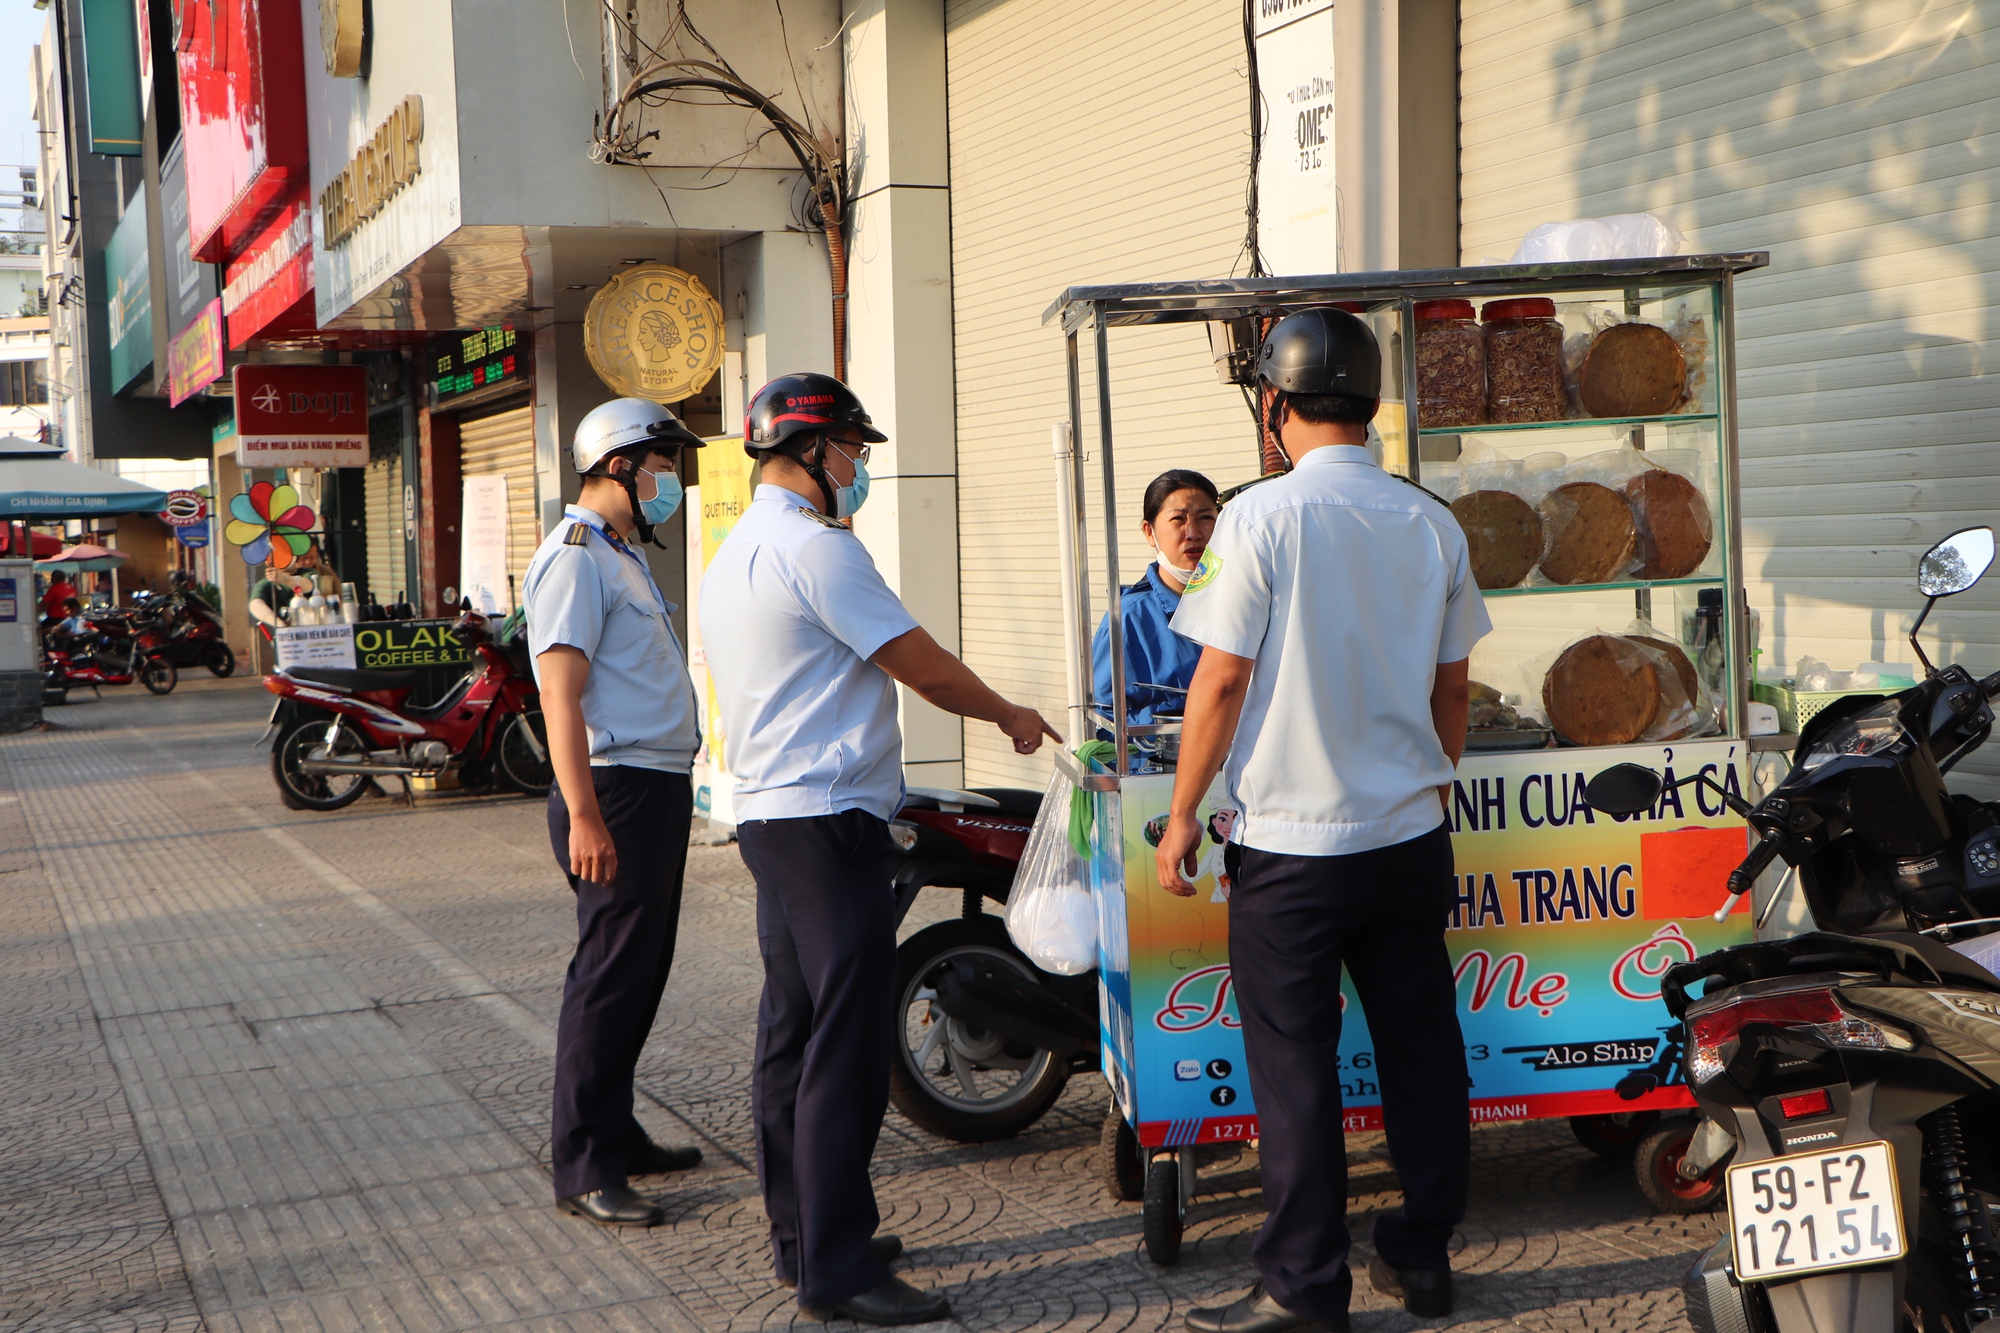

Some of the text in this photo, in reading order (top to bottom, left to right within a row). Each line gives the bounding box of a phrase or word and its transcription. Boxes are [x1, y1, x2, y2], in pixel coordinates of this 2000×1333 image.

[608, 282, 707, 369] THE FACE SHOP
[640, 366, 679, 376] NATURAL
[643, 376, 674, 385] STORY
[288, 392, 355, 422] DOJI
[796, 395, 835, 405] YAMAHA
[270, 441, 290, 450] MUA
[10, 495, 108, 508] CHI NHÁNH GIA ĐỊNH
[165, 514, 202, 525] COFFEE
[365, 649, 435, 667] COFFEE
[440, 648, 451, 662] &
[1444, 776, 1507, 834] NH
[1519, 772, 1596, 829] CUA
[1695, 745, 1742, 818] CÁ
[1445, 864, 1636, 930] HA TRANG
[1540, 1043, 1655, 1066] Alo Ship
[1213, 1124, 1244, 1138] 127
[1469, 1103, 1528, 1121] THẠNH
[1786, 1131, 1838, 1146] HONDA
[1751, 1153, 1870, 1215] 59-F2
[1742, 1204, 1892, 1271] 121.54
